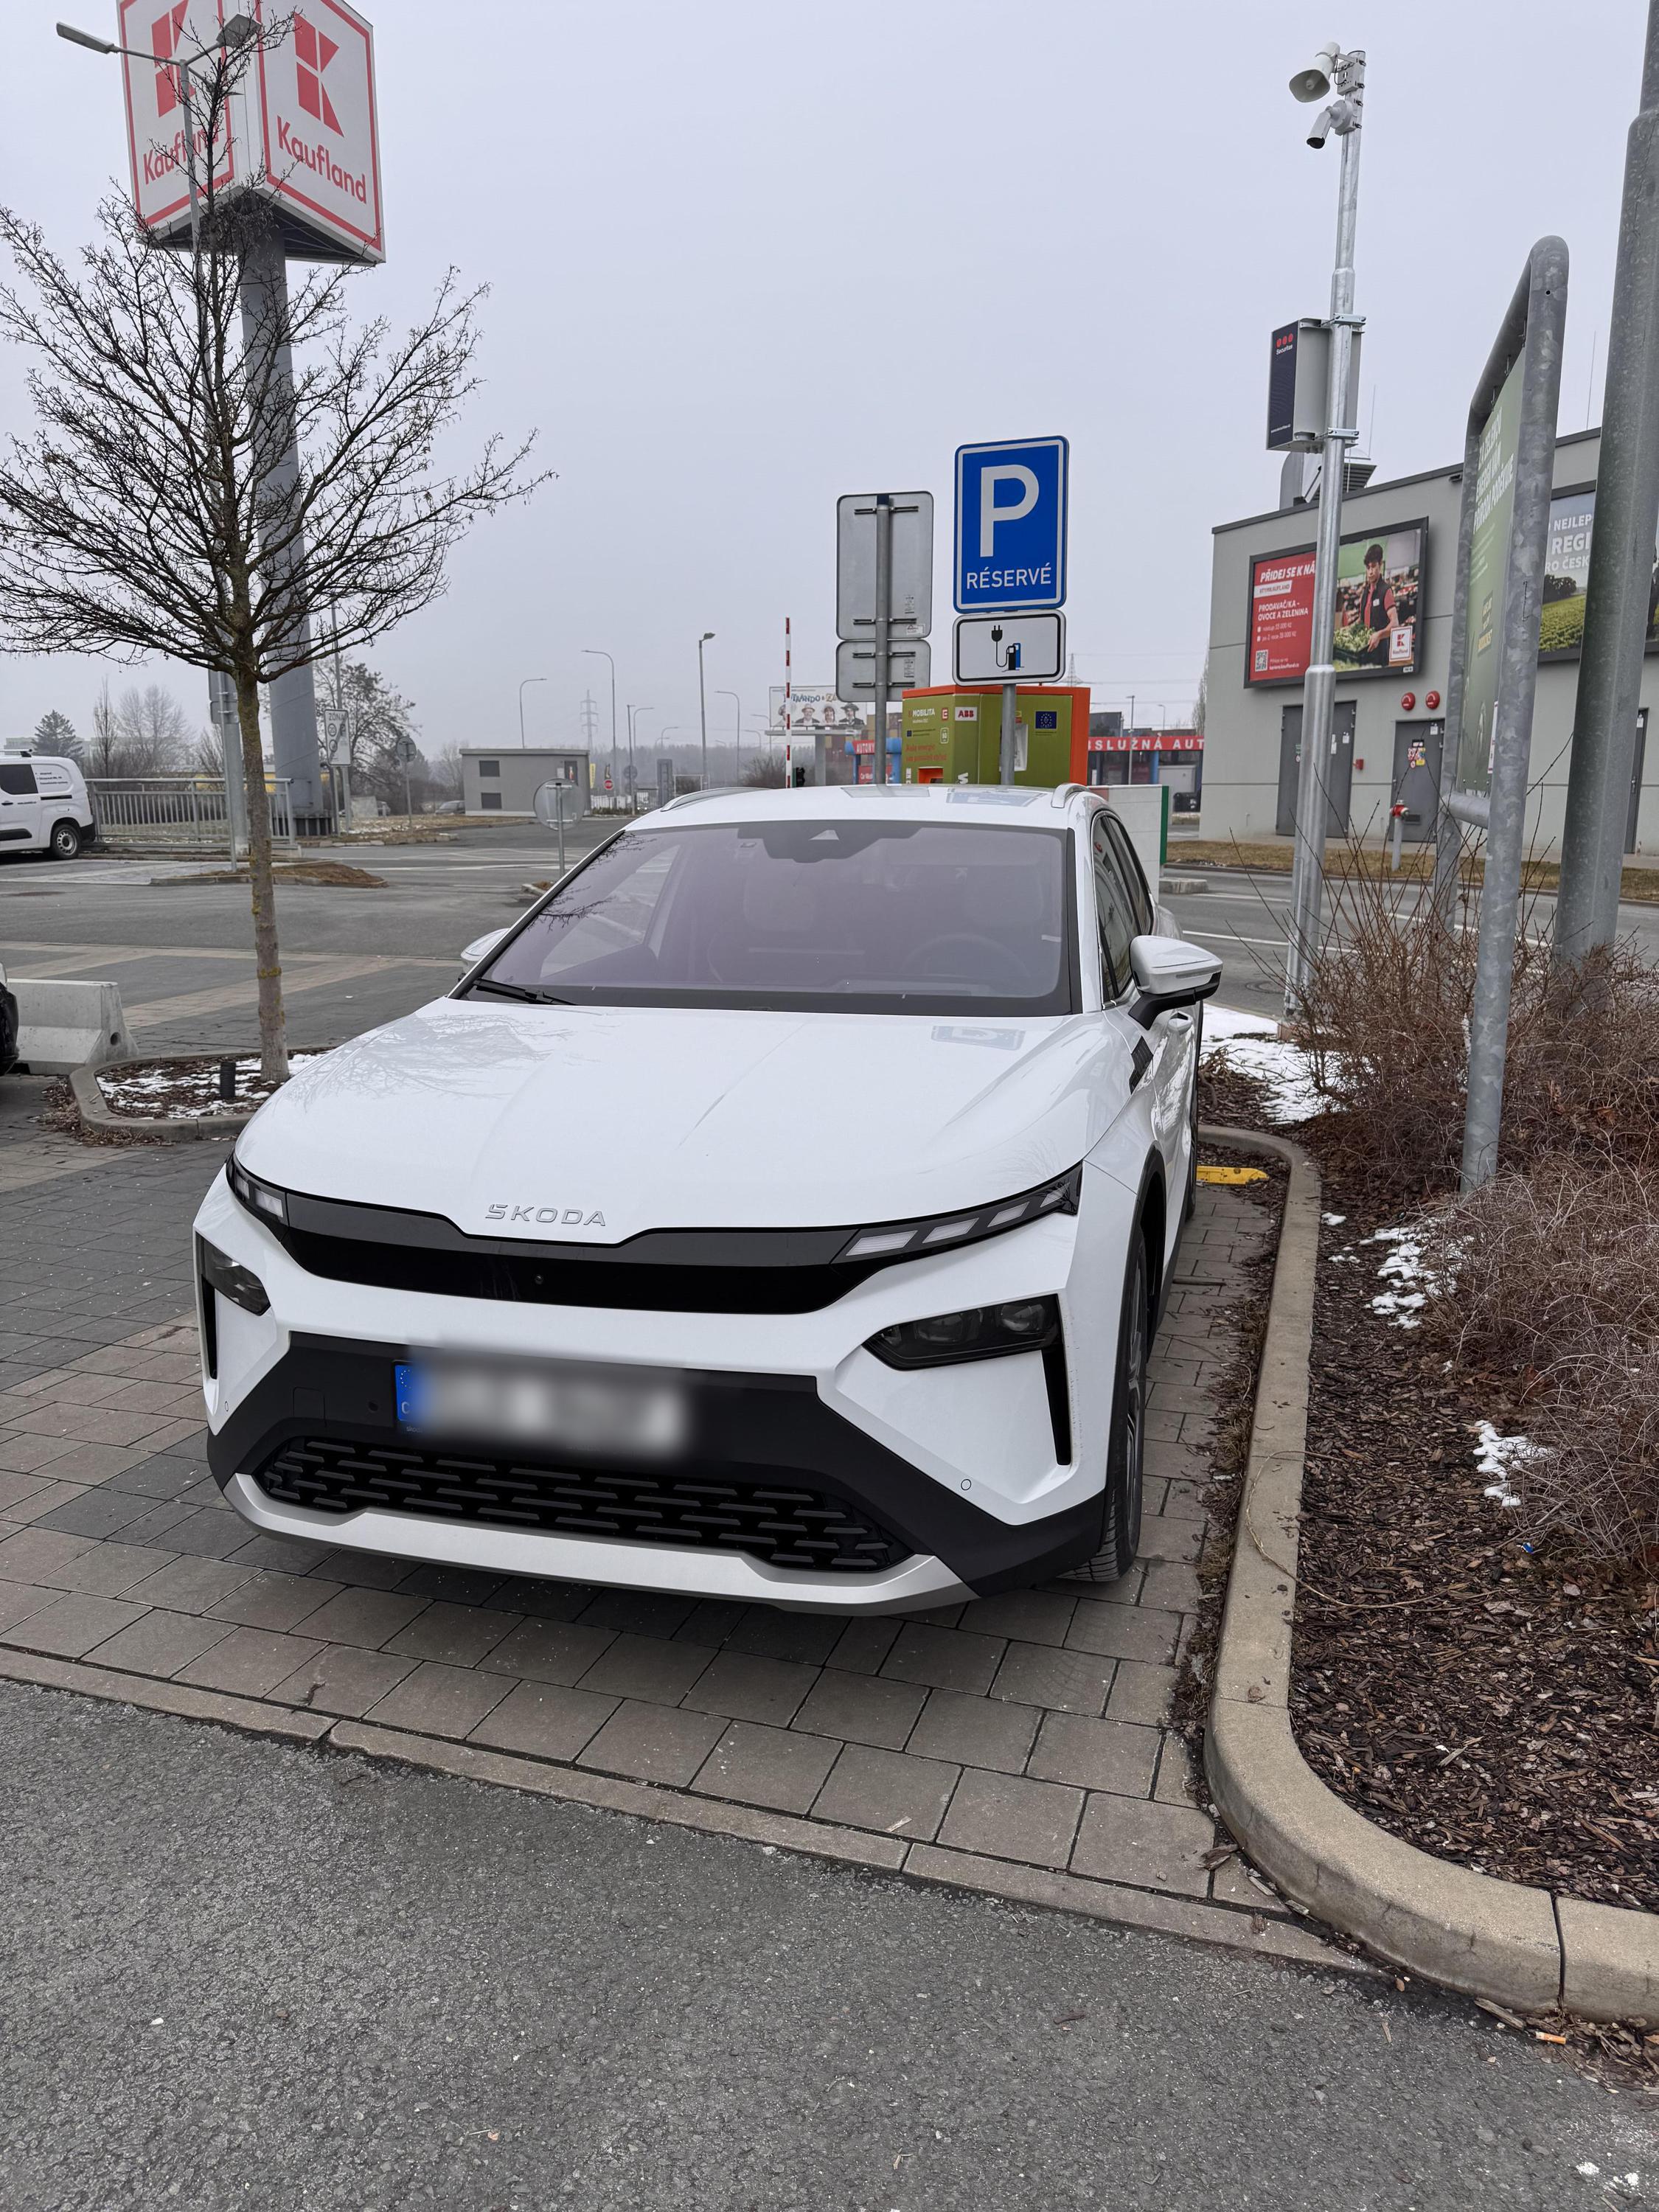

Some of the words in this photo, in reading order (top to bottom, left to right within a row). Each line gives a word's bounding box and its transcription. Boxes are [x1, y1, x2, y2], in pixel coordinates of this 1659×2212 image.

[276, 115, 366, 204] Kaufland
[1276, 344, 1293, 355] Securitas
[980, 465, 1040, 557] P
[1554, 514, 1593, 532] NEJLEP
[1551, 532, 1591, 555] REGI
[1260, 568, 1286, 582] PŘIDEJ
[1286, 567, 1296, 578] SE
[1296, 565, 1304, 576] K
[1304, 560, 1315, 576] NÁ
[1545, 560, 1559, 574] RO
[1562, 554, 1590, 570] ČESK
[967, 563, 1051, 590] RÉSERVÉ
[1258, 612, 1276, 621] OVOCE
[1281, 608, 1309, 619] ZELENINA
[958, 710, 974, 718] ABB
[856, 742, 875, 754] AUTOMY
[1088, 732, 1163, 751] SLUŽNÁ
[1172, 739, 1205, 749] AUT
